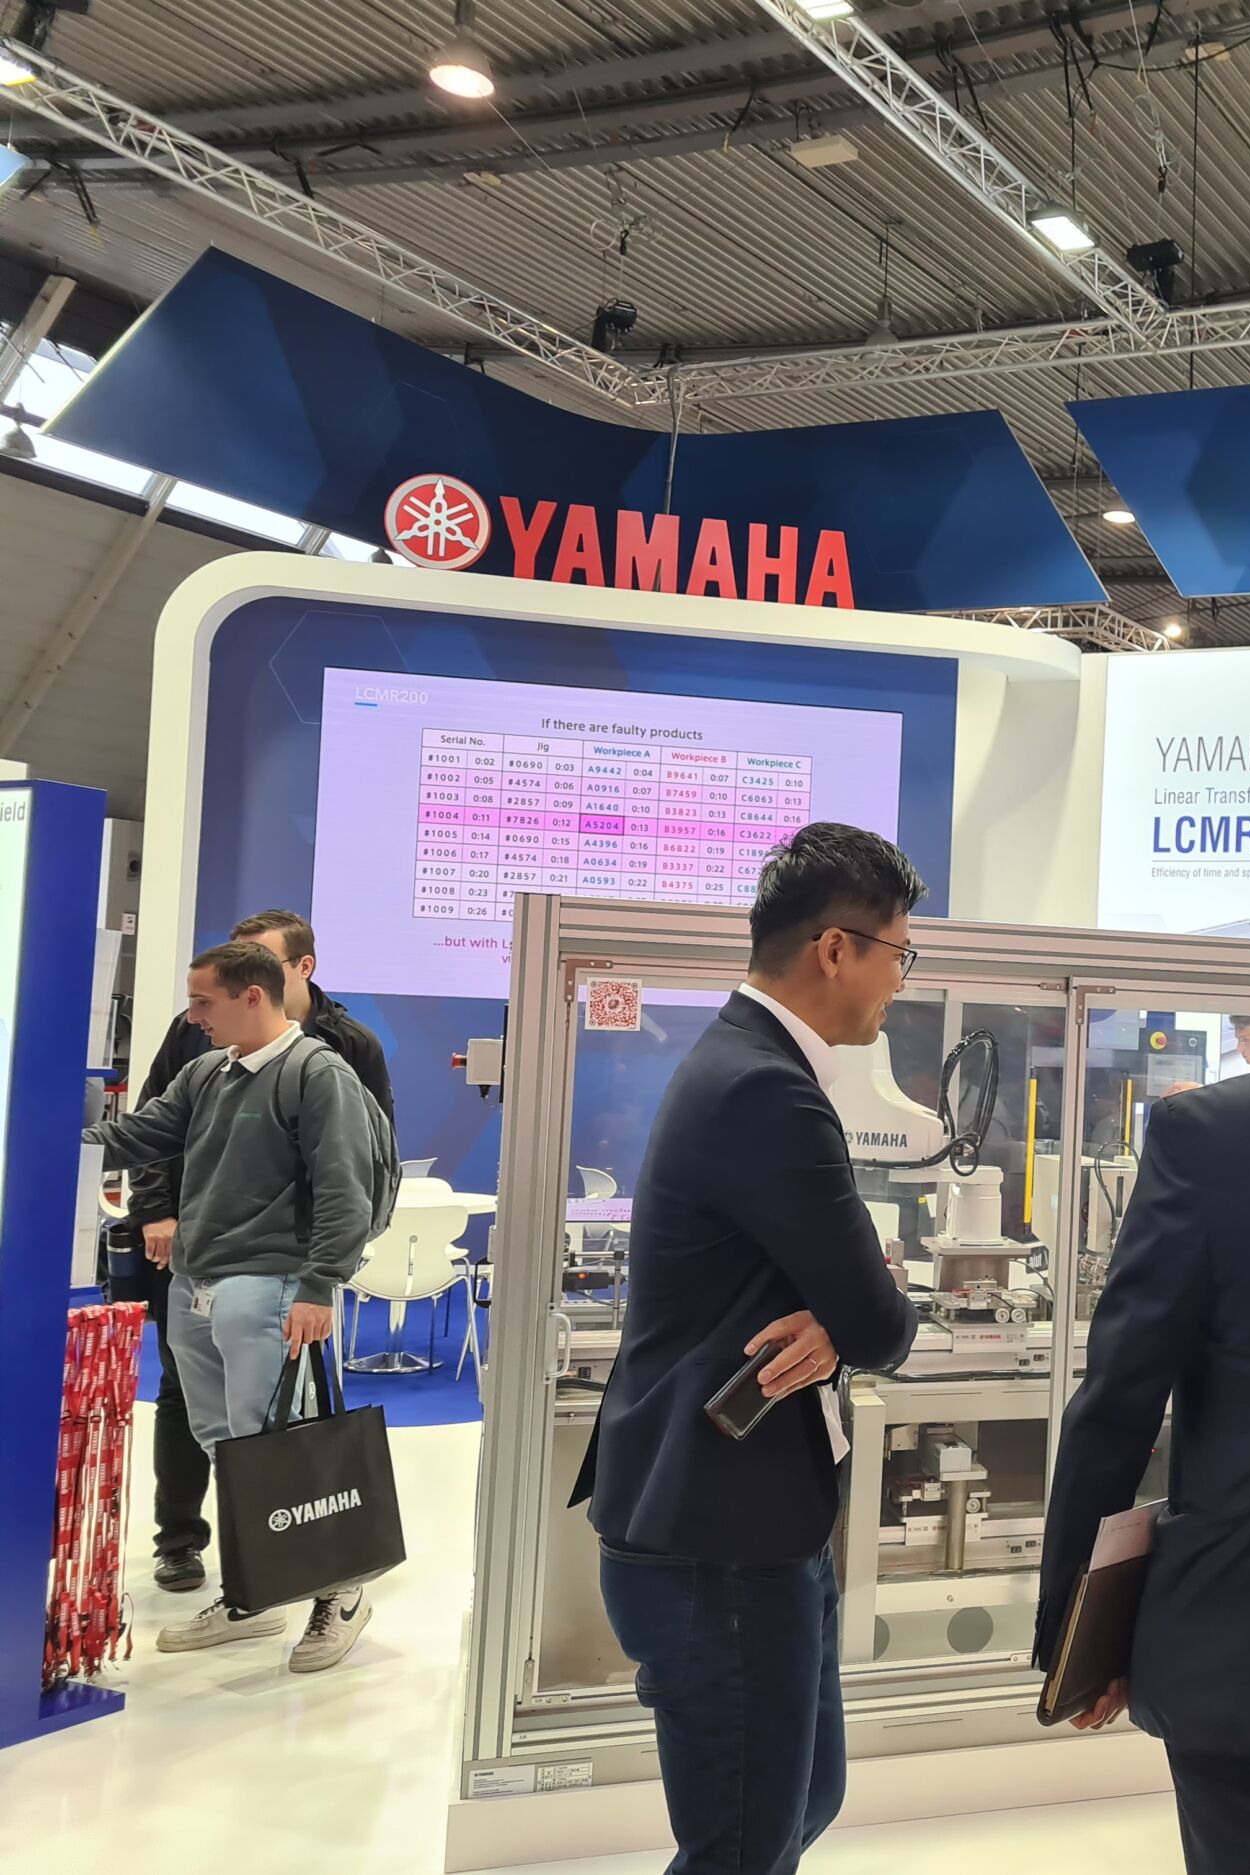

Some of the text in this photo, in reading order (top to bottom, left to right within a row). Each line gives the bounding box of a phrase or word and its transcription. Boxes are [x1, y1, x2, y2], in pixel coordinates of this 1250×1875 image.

[500, 496, 855, 610] YAMAHA
[355, 687, 428, 705] LCMR200
[542, 718, 703, 742] If there are faulty products
[440, 735, 801, 769] Serial No. Jig Workpiece A Workpiece B Workpiece C
[428, 754, 803, 788] #1001 0:02 #0690 0:03 A9442 0:04 B9641 0:07 C3425 0:10
[427, 773, 802, 806] #1002 0:05 #4574 0:06 A0916 0:07 B7459 0:10 C6063 0:13
[1154, 788, 1200, 805] Linear
[0, 801, 26, 822] ield
[426, 792, 801, 824] #1003 0:08 #2857 0:09 A1640 0:10 B3823 0:13 C8644 0:16
[425, 810, 459, 820] #1004
[472, 814, 490, 822] 0:11
[506, 816, 540, 825] #7826
[552, 818, 571, 827] 0:12
[585, 820, 619, 830] A5204
[630, 824, 649, 832] 0:13
[664, 826, 696, 835] B3957
[707, 828, 726, 837] 0:16
[739, 830, 772, 840] C3622
[424, 829, 768, 858] #1005 0:14 #0690 0:15 A4396 0:16 B6822 0:19 C189
[423, 848, 457, 858] #1006
[470, 851, 489, 860] 0:17
[504, 853, 537, 862] #4574
[550, 855, 570, 864] 0:18
[583, 857, 617, 867] A0634
[629, 860, 648, 869] 0:19
[662, 862, 694, 871] B3337
[706, 865, 725, 873] 0:22
[422, 866, 757, 893] #1007 0:20 #2857 0:21 A0593 0:22 B4375 0:25 C88
[1151, 867, 1191, 880] Efficiency
[1192, 867, 1202, 878] of
[1203, 867, 1222, 878] time
[1224, 867, 1240, 878] and
[421, 885, 488, 897] #1008 0:23
[420, 904, 487, 916] #1009 0:26
[470, 937, 498, 948] with
[856, 1132, 908, 1148] YAMAHA
[291, 1488, 362, 1526] YAMAHA
